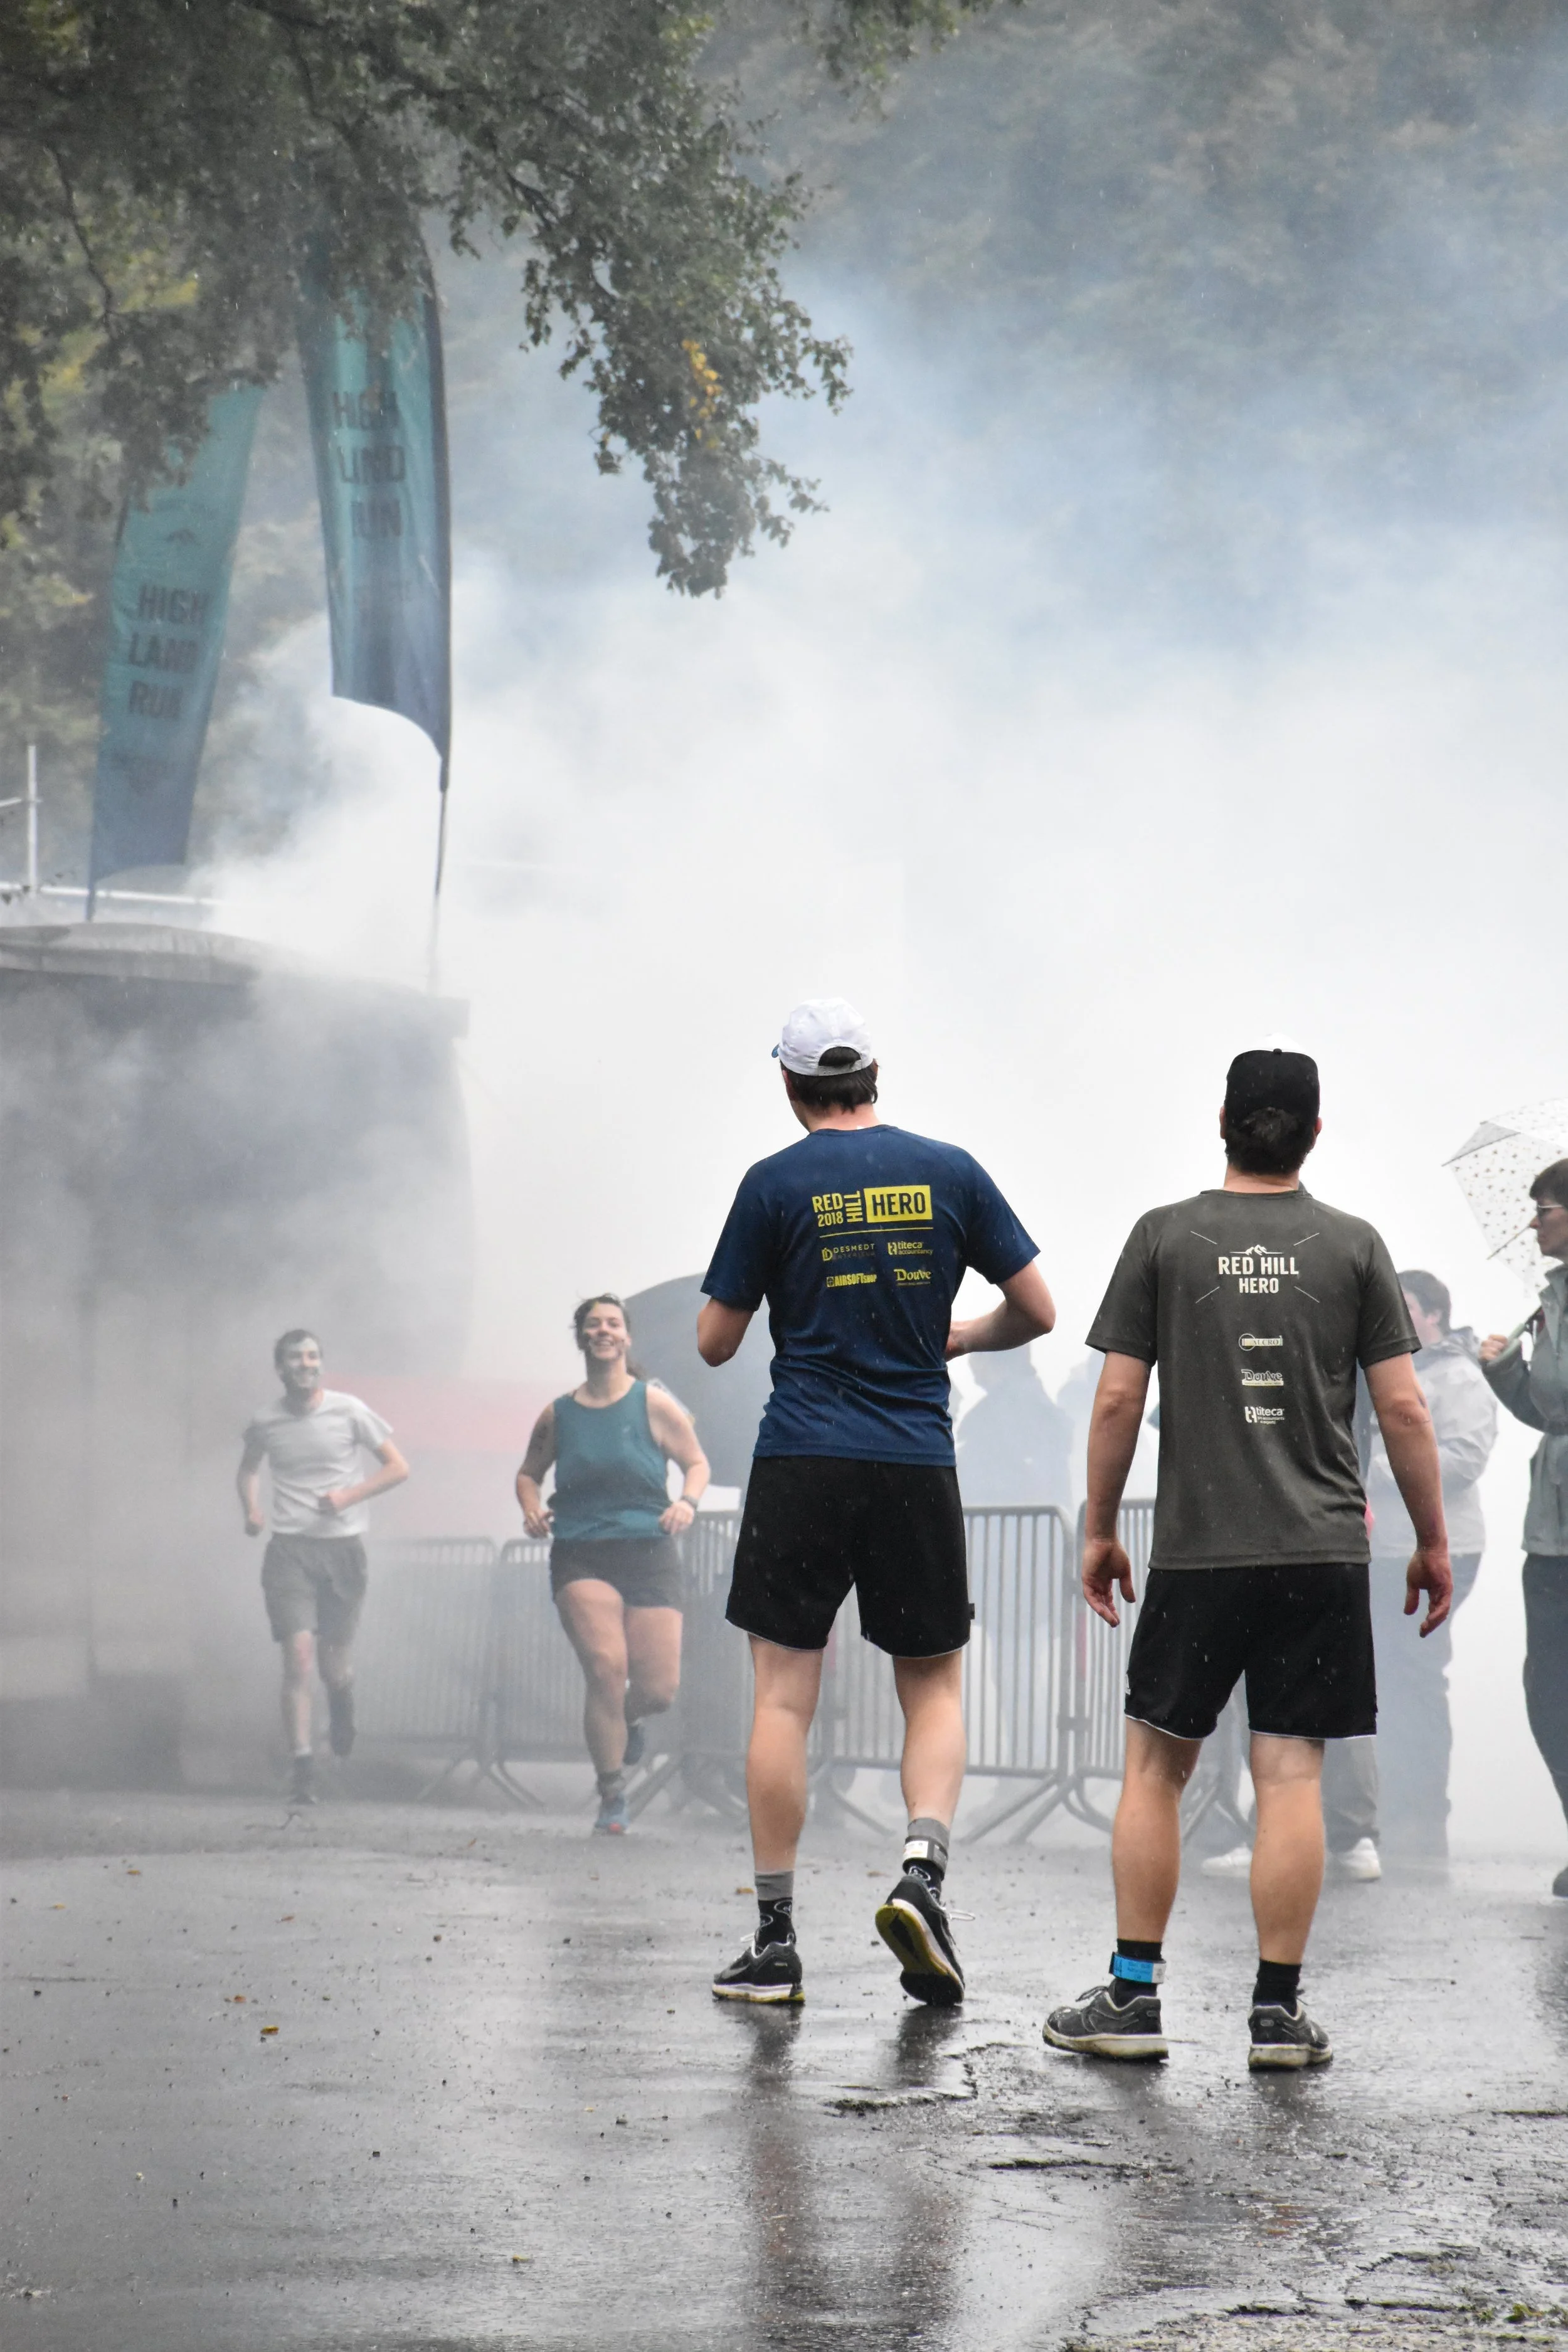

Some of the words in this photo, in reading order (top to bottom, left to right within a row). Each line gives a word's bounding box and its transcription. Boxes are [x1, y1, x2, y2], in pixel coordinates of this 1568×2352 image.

[137, 583, 211, 624] HIGH
[128, 632, 199, 674] LAND
[128, 680, 184, 719] RUN
[812, 1193, 843, 1213] RED
[844, 1190, 863, 1222] HILL
[872, 1192, 926, 1216] HERO
[817, 1212, 844, 1227] 2018
[834, 1244, 875, 1253] DESMEDT
[898, 1241, 923, 1249] titeca
[1219, 1257, 1254, 1275] RED
[1261, 1257, 1299, 1275] HILL
[1239, 1278, 1279, 1293] HERO
[1256, 1406, 1283, 1416] titeca
